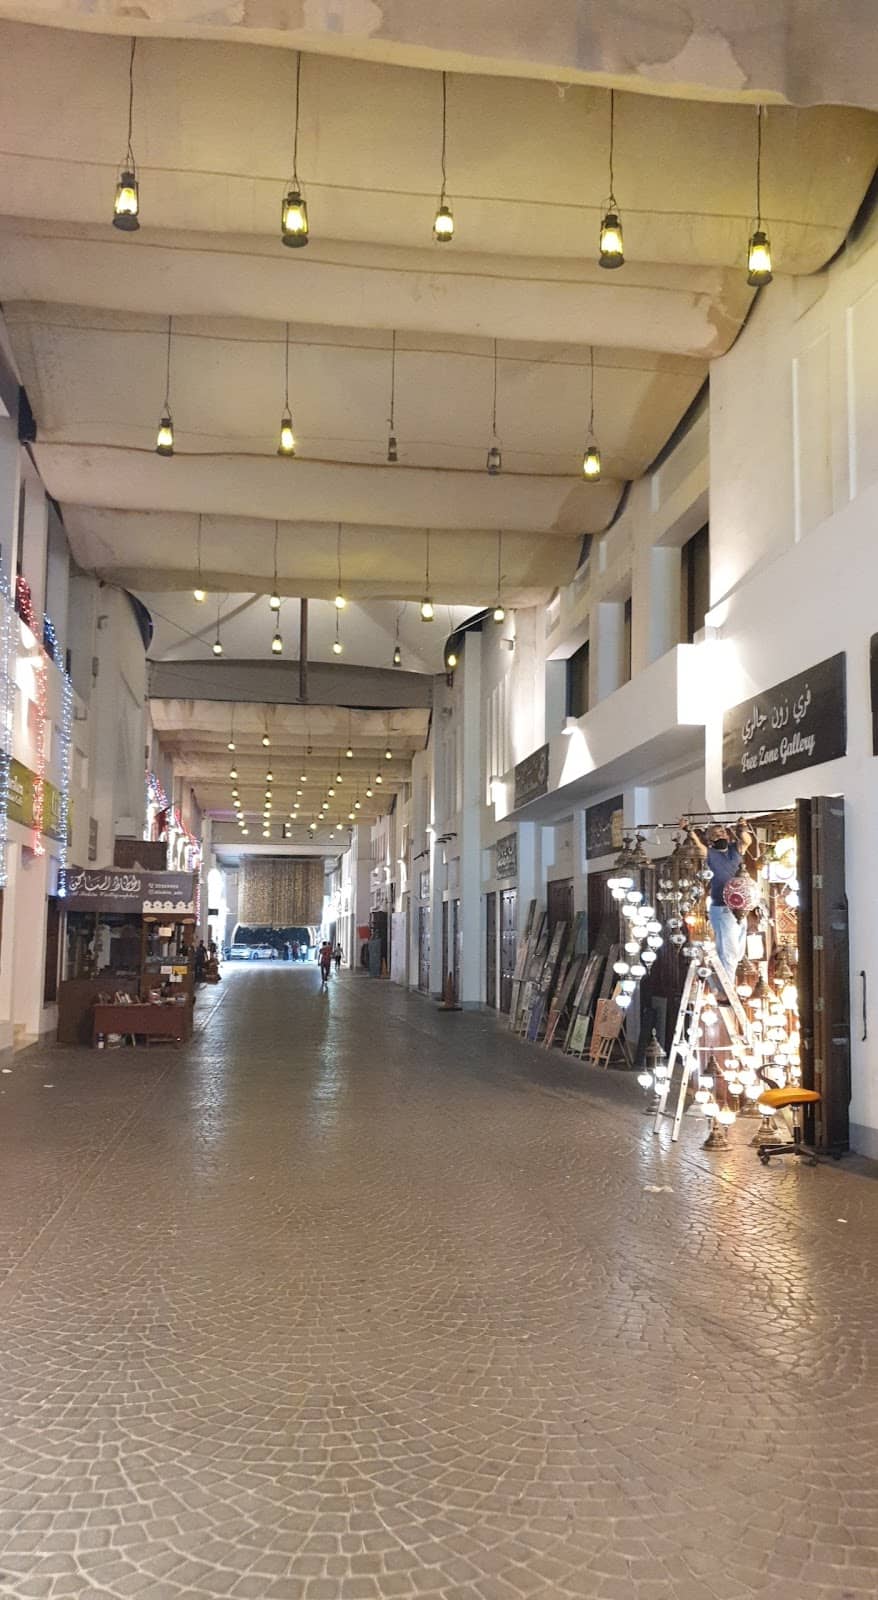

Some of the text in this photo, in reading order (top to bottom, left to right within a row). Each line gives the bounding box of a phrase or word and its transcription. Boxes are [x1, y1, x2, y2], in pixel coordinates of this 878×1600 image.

[771, 698, 789, 729] زون
[793, 683, 811, 724] فري
[741, 732, 815, 772] Free Zone Gallery
